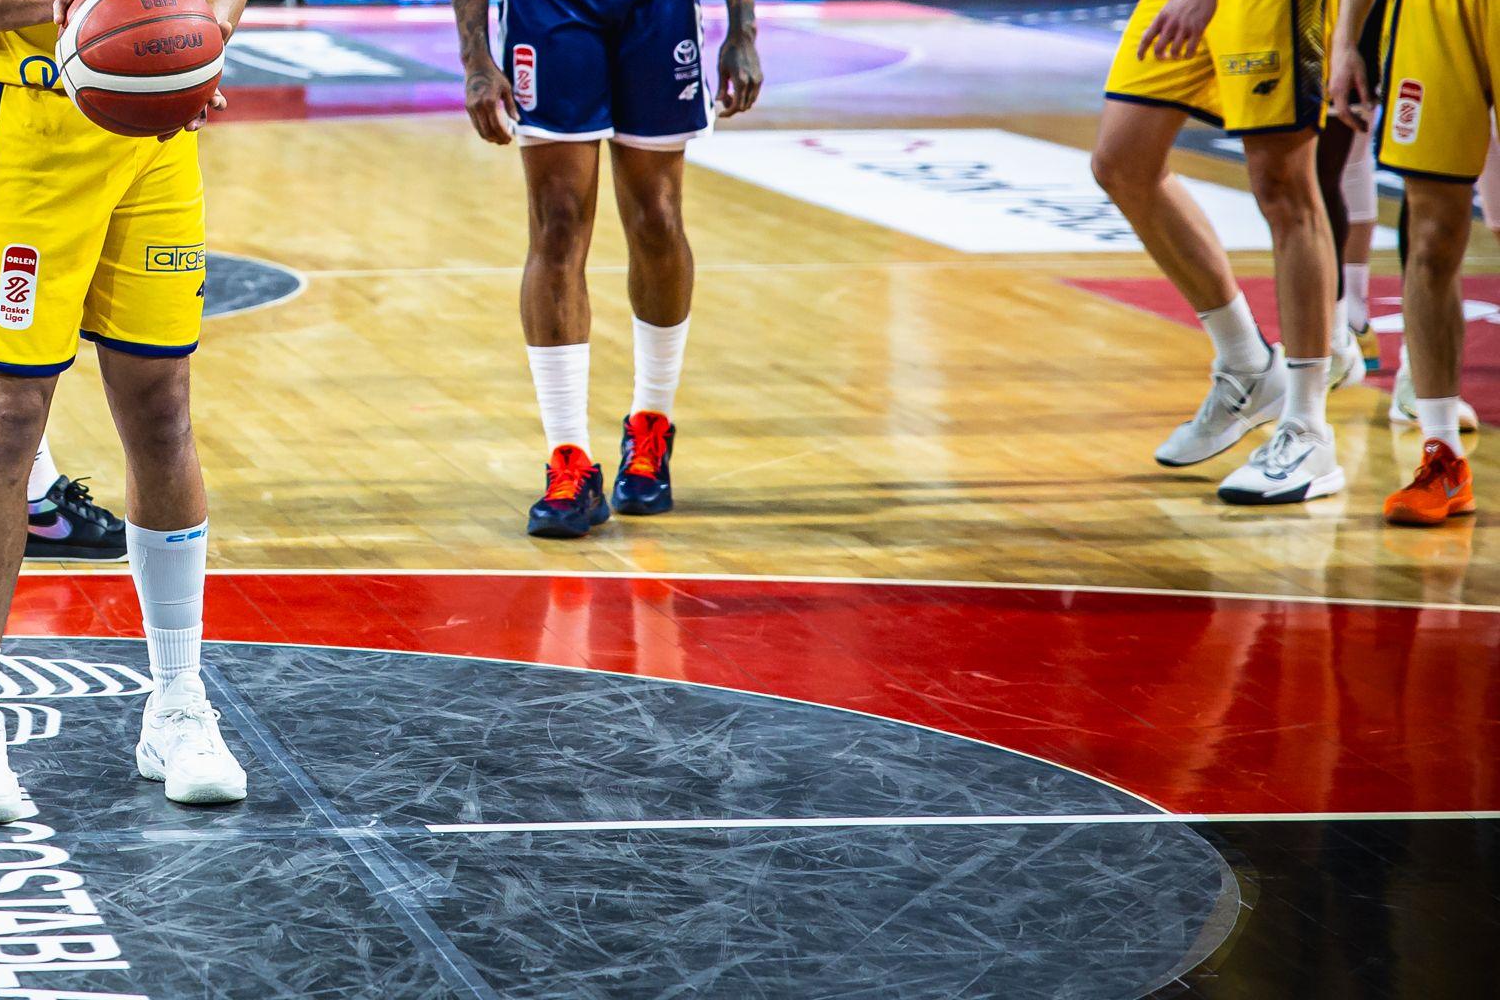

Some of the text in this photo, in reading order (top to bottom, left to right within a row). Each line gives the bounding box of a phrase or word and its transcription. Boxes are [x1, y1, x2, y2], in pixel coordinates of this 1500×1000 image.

[133, 32, 203, 58] molten
[6, 255, 36, 266] ORLEN
[0, 304, 30, 315] Basket
[5, 313, 23, 325] Liga
